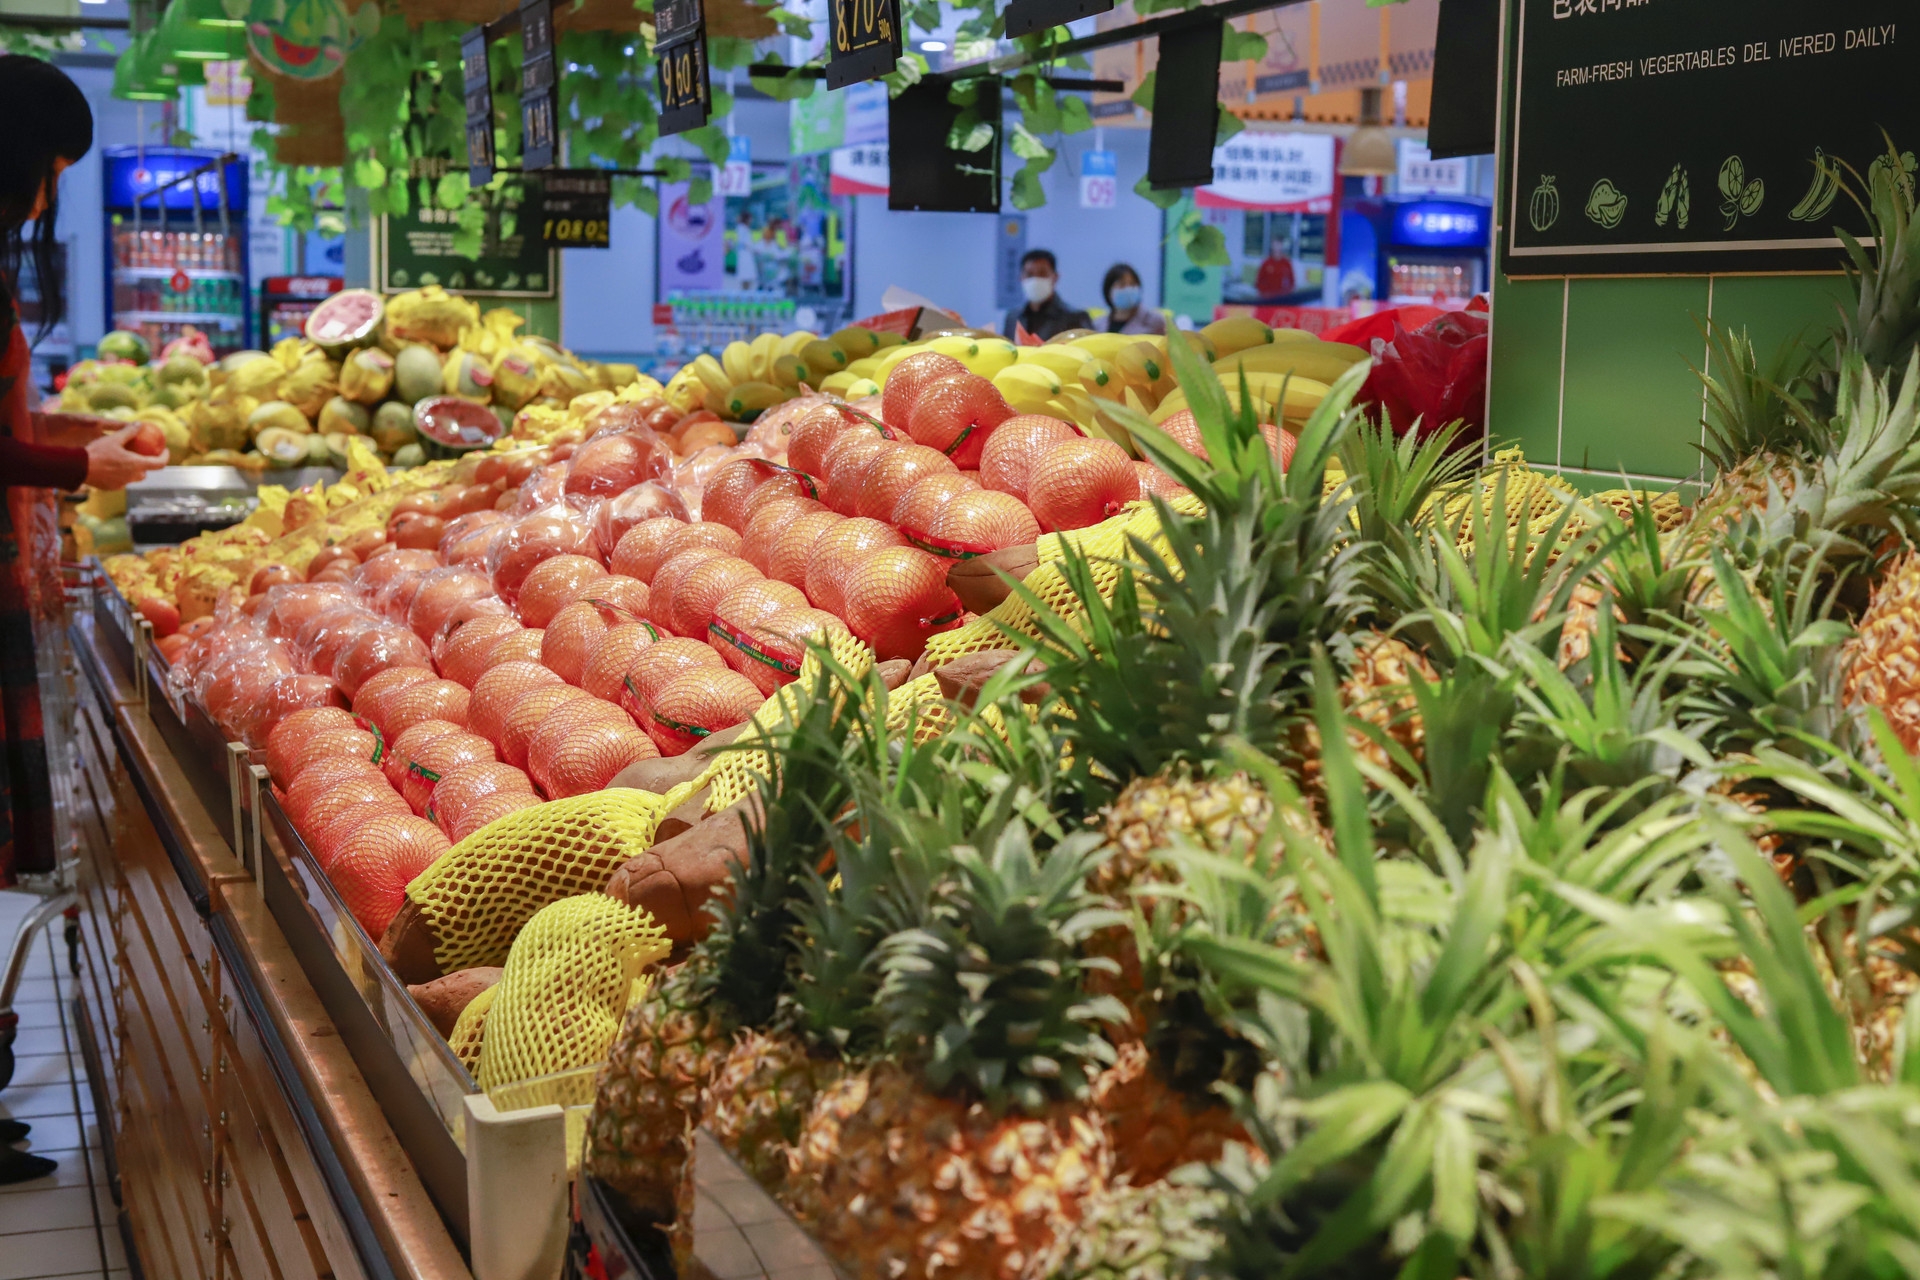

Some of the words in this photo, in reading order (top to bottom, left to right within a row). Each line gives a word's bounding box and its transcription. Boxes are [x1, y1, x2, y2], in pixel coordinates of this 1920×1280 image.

[1556, 60, 1633, 88] FARM-FRESH
[1639, 45, 1736, 76] VEGERTABLES
[1743, 41, 1771, 63] DEL
[1779, 32, 1836, 58] IVERED
[1844, 23, 1896, 50] DAILY!
